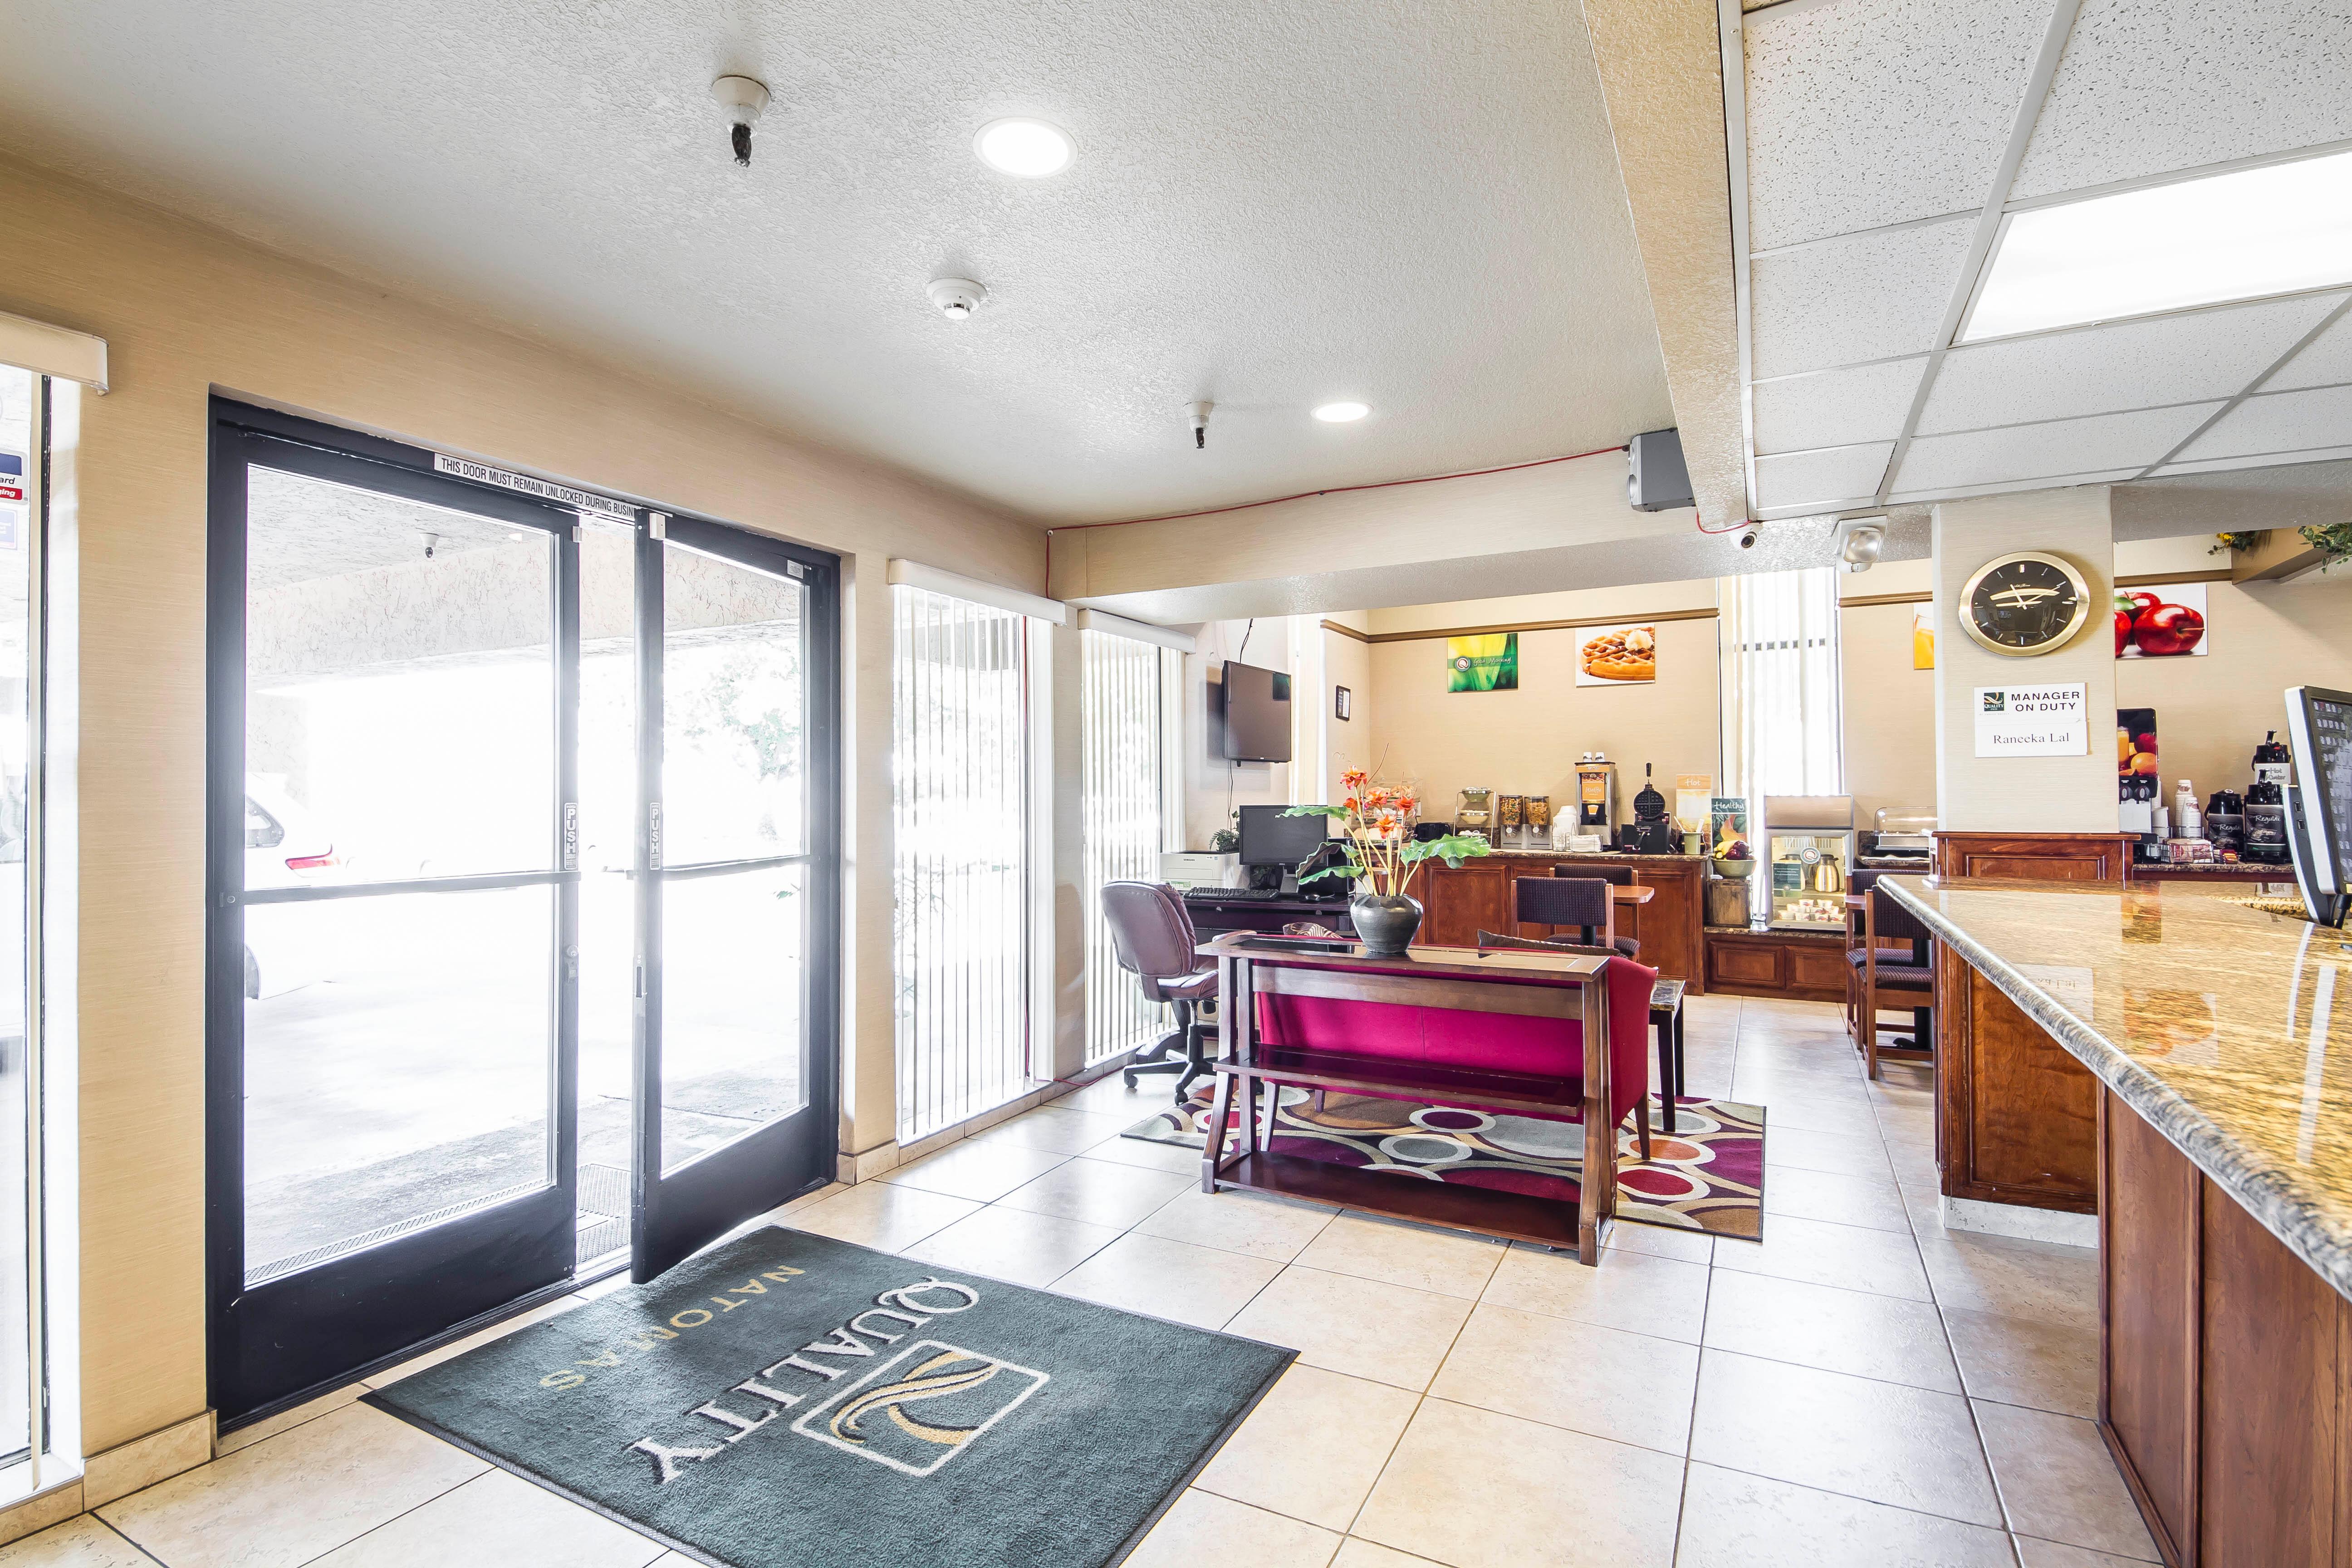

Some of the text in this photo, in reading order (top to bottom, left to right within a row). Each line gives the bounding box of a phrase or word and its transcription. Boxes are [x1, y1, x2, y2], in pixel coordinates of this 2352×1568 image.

[441, 458, 461, 473] THIS
[463, 463, 486, 480] DOOR
[489, 470, 512, 486] MUST
[514, 477, 543, 494] REMAIN
[545, 485, 583, 504] UNLOCKED
[585, 495, 612, 511] DURING
[2011, 691, 2080, 701] MANAGER
[2015, 702, 2076, 712] ON DUTY
[1994, 732, 2069, 744] Raneeka Lal
[1685, 778, 1701, 787] Hot
[1714, 801, 1745, 812] Healthy
[2254, 815, 2280, 824] Regular
[567, 808, 576, 853] PUSH
[624, 1276, 981, 1485] QUALITY
